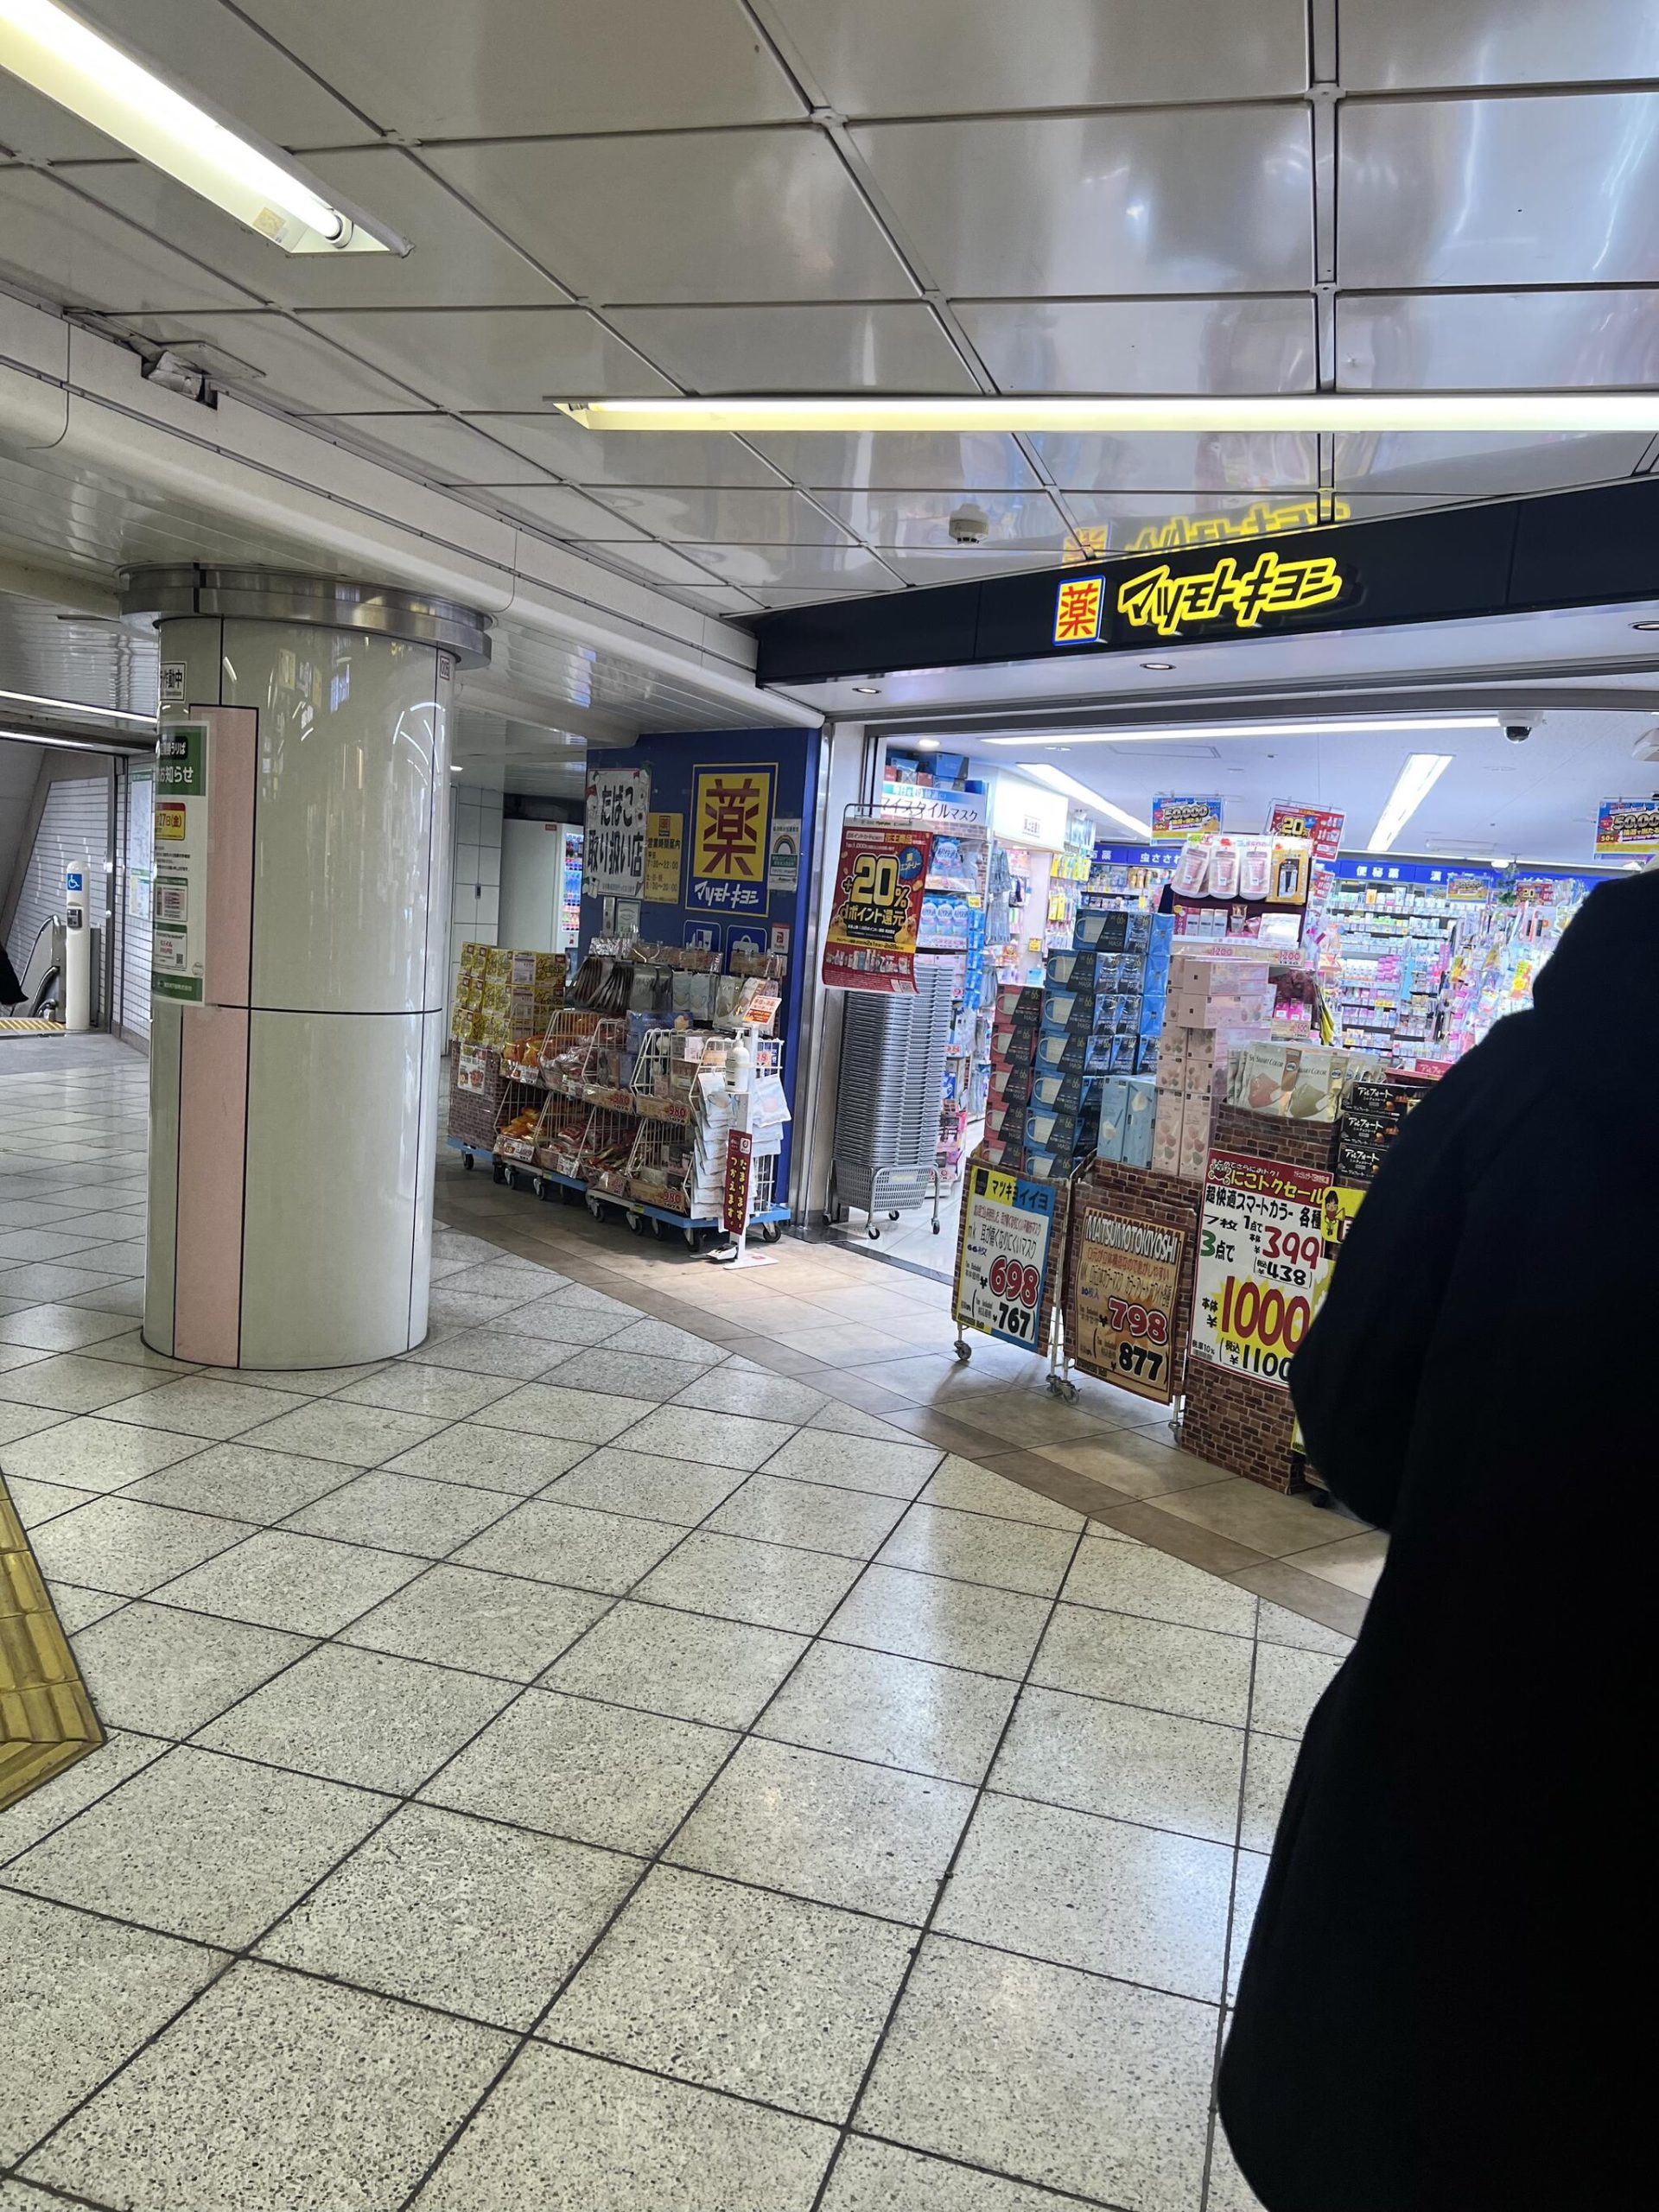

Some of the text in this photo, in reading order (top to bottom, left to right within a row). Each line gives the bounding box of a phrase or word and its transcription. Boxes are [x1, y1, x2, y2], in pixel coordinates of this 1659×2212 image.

[1058, 551, 1343, 639] 薬 マツモトキヨシ
[600, 785, 633, 827] たばこ
[702, 779, 760, 875] 薬
[588, 830, 644, 876] 取り扱い店
[695, 880, 759, 908] マツモトキヨシ
[839, 903, 906, 926] dポイント還元
[1357, 1086, 1394, 1098] アルフォート
[1349, 1117, 1384, 1130] アルフォート
[1344, 1148, 1380, 1162] アルフォート
[992, 1179, 1049, 1211] マツキヨイイヨ
[1230, 1169, 1323, 1205] にこトクセール
[1205, 1185, 1294, 1221] 超快適スマートカラー
[1300, 1206, 1321, 1230] 各種
[1085, 1214, 1179, 1264] MATSUMOTOKIYOSHI
[1200, 1228, 1236, 1262] 3点で
[1202, 1297, 1218, 1313] 本体
